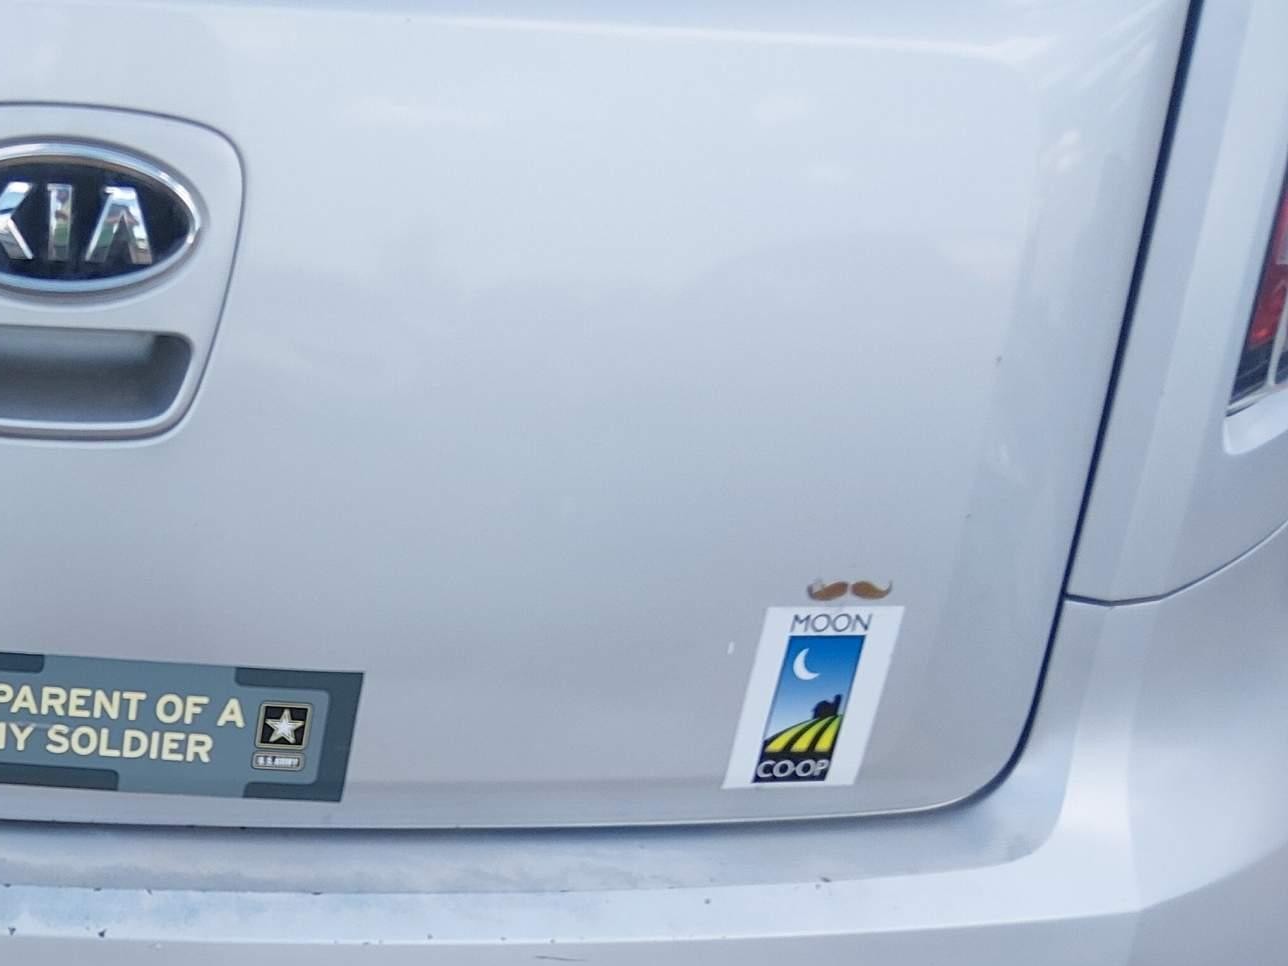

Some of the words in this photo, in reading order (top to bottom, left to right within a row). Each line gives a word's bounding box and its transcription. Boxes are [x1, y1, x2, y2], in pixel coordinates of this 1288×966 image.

[790, 612, 873, 633] MOON
[155, 693, 210, 727] OF
[216, 696, 246, 729] A
[45, 723, 214, 763] SOLDIER
